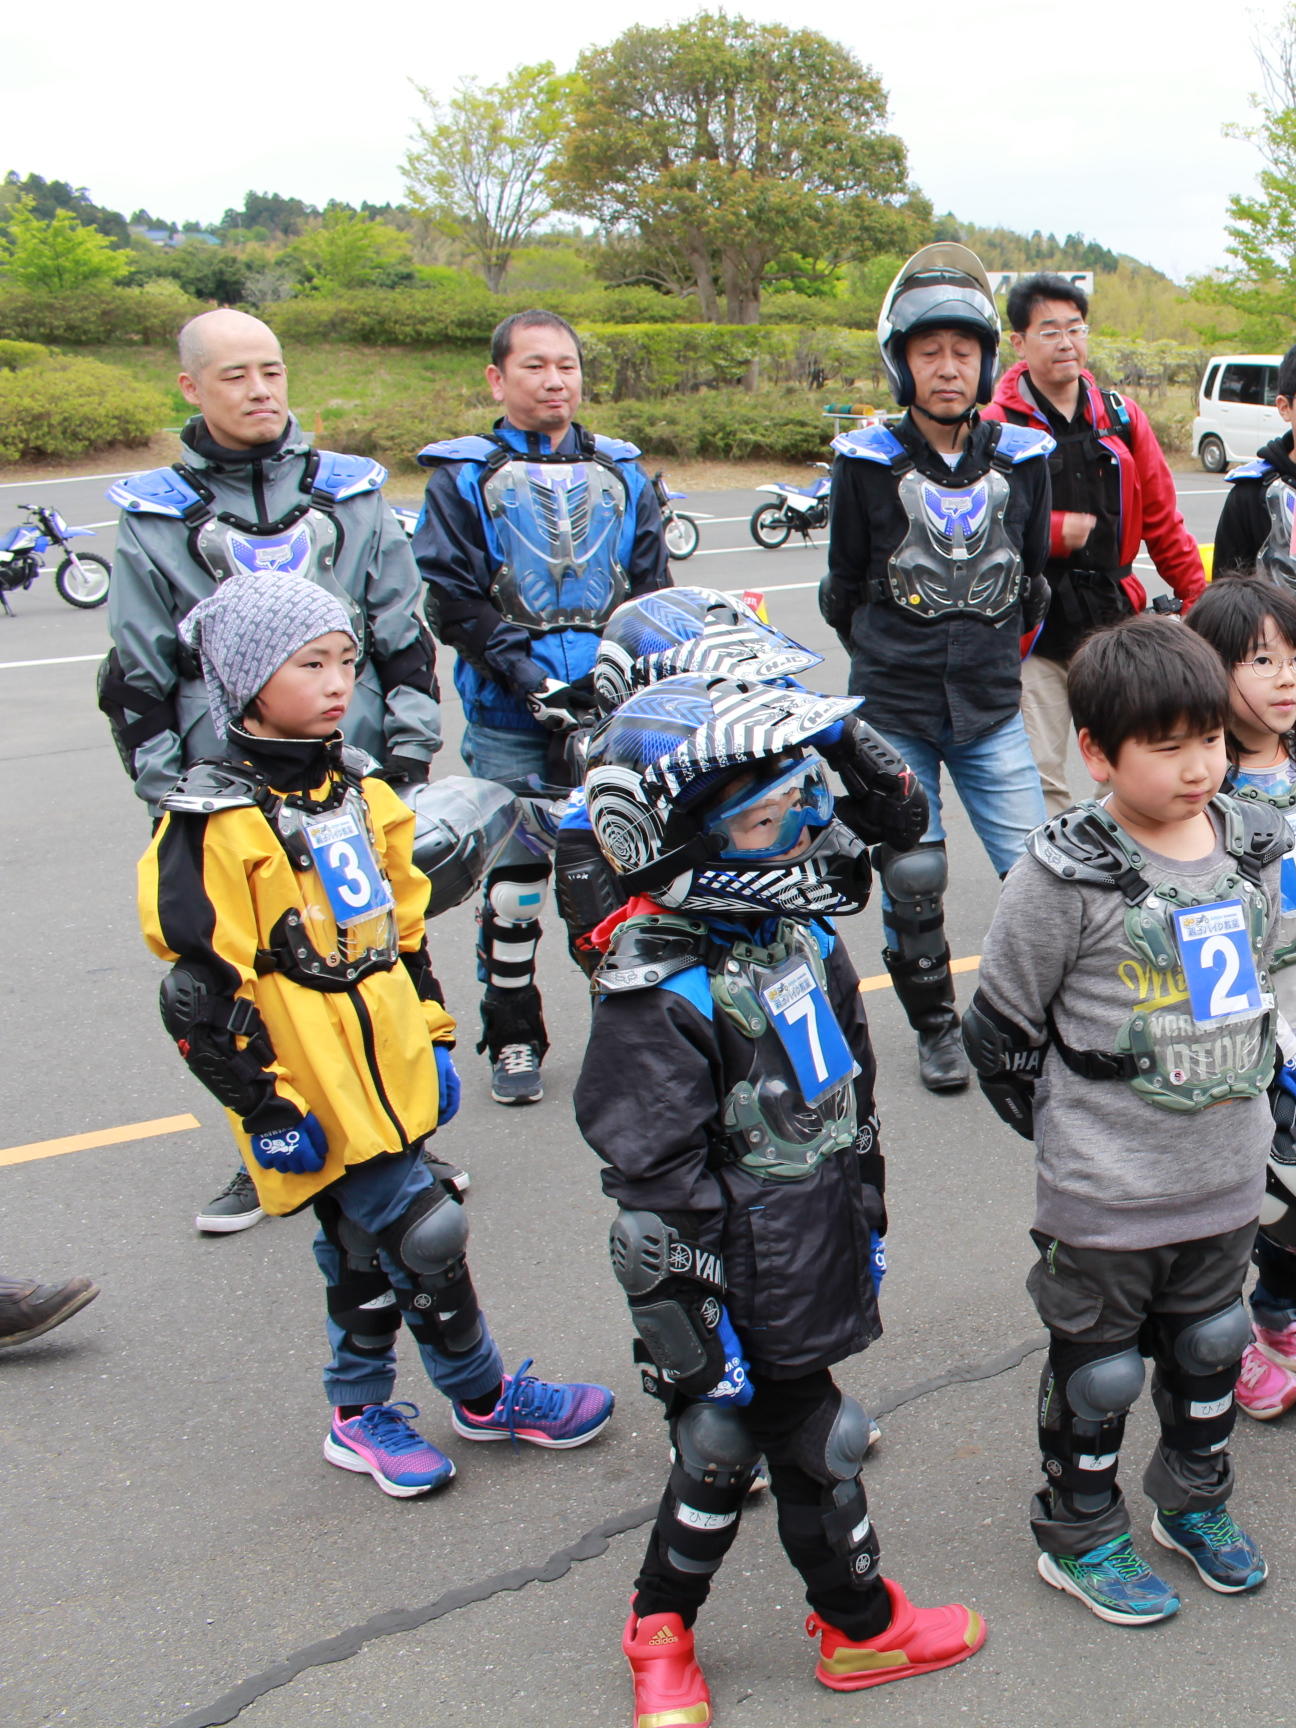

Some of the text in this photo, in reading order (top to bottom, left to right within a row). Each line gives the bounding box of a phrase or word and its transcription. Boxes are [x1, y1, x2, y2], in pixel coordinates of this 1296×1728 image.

[329, 840, 371, 907] 3
[1200, 935, 1250, 1017] 2
[783, 993, 829, 1083] 7
[649, 1635, 679, 1646] adidas
